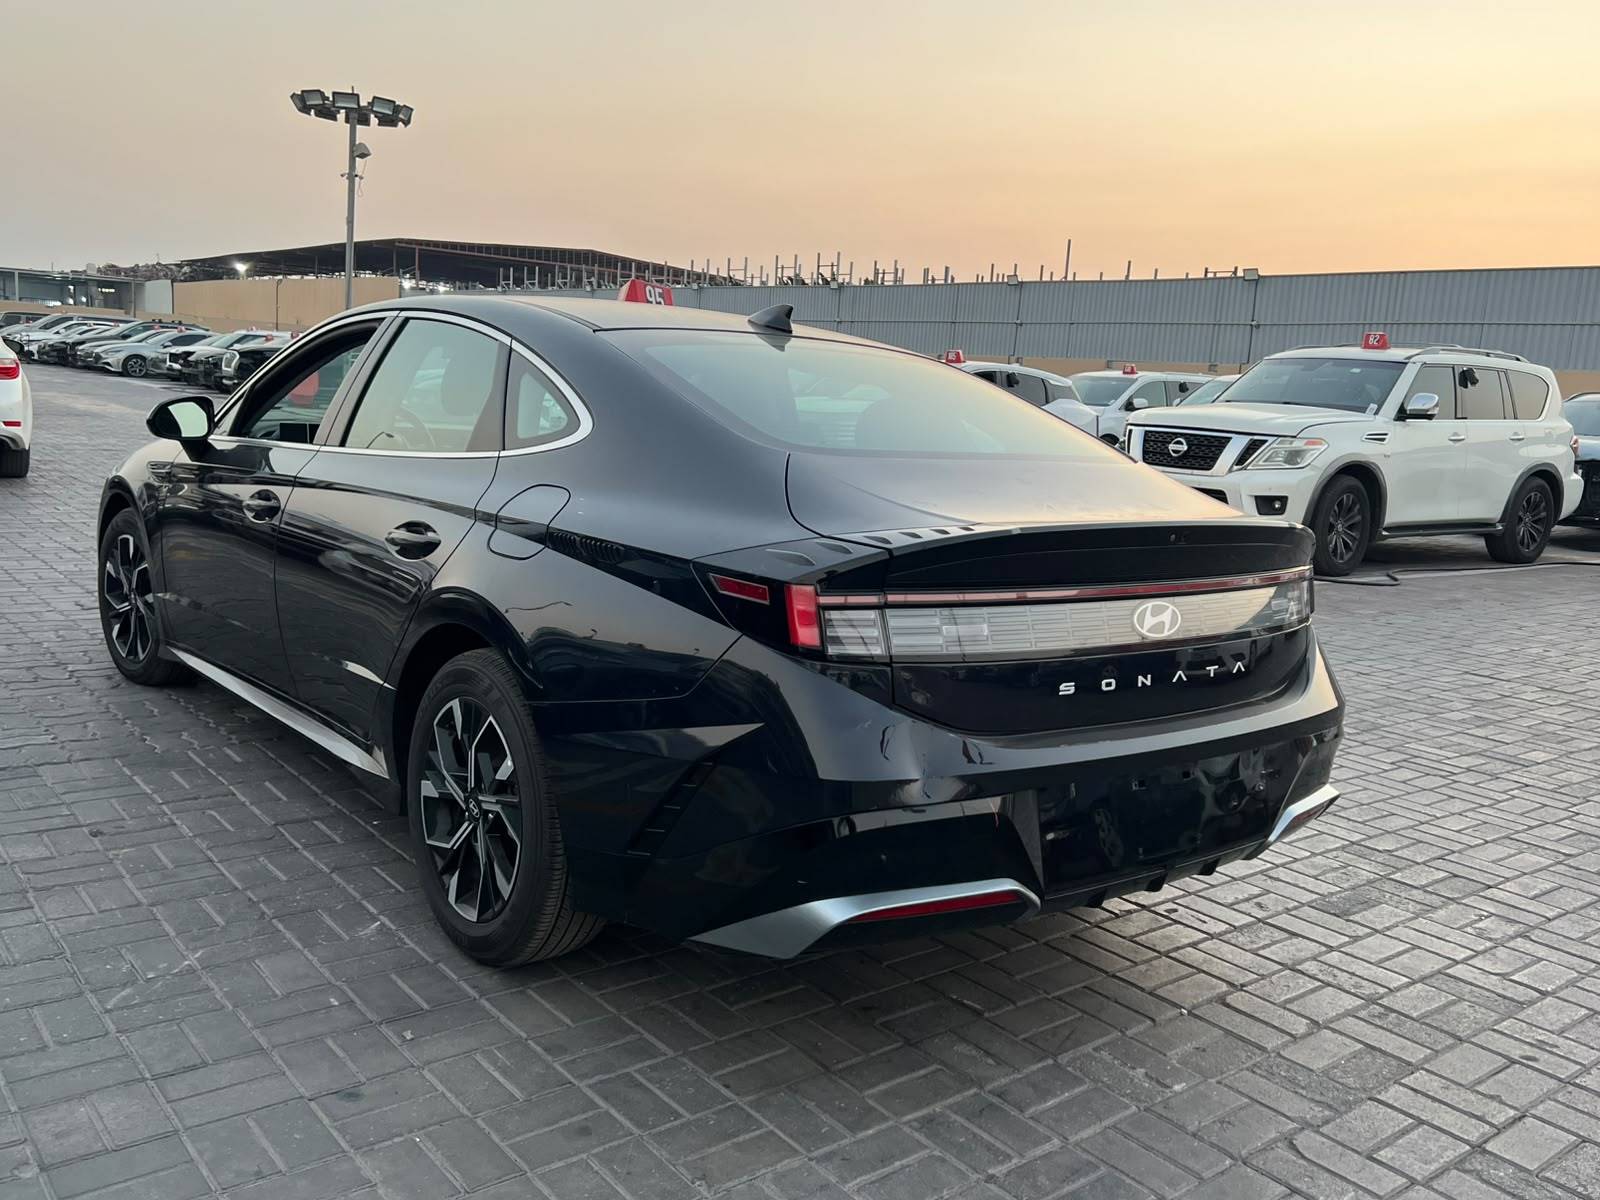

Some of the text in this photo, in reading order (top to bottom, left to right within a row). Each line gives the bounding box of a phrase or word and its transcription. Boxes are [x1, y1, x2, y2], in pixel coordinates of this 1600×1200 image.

[645, 285, 665, 306] 95
[1368, 334, 1380, 345] 82
[1058, 661, 1246, 696] SONATA
